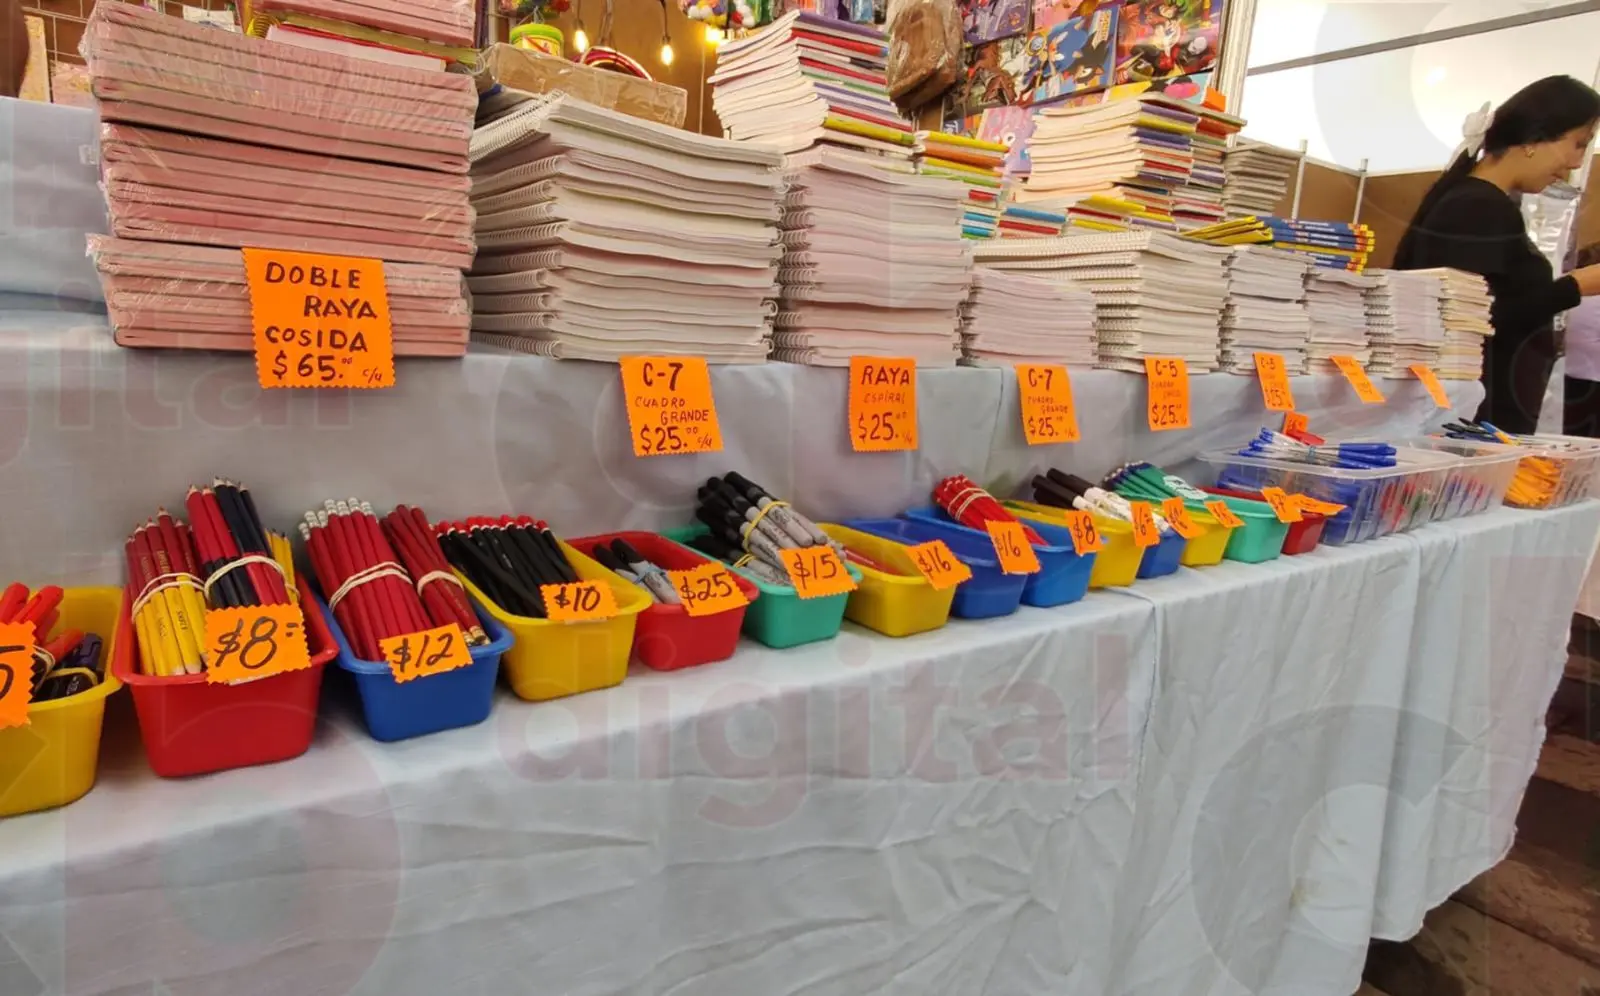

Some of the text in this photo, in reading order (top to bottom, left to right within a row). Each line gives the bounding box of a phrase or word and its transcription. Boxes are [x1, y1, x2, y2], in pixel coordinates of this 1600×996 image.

[265, 261, 361, 288] DOBLE
[303, 295, 377, 319] RAYA
[265, 325, 368, 352] COSIDA
[642, 362, 683, 391] C-7
[861, 365, 910, 385] RAYA
[1028, 368, 1053, 391] C-7
[1155, 360, 1178, 377] C-5
[635, 396, 686, 408] CUADRO
[661, 409, 709, 426] GRANDE
[1073, 515, 1096, 555] $8
[793, 553, 838, 590] $15
[918, 546, 951, 581] $16
[554, 585, 600, 612] $10
[679, 572, 732, 609] $25
[393, 632, 454, 673] $12
